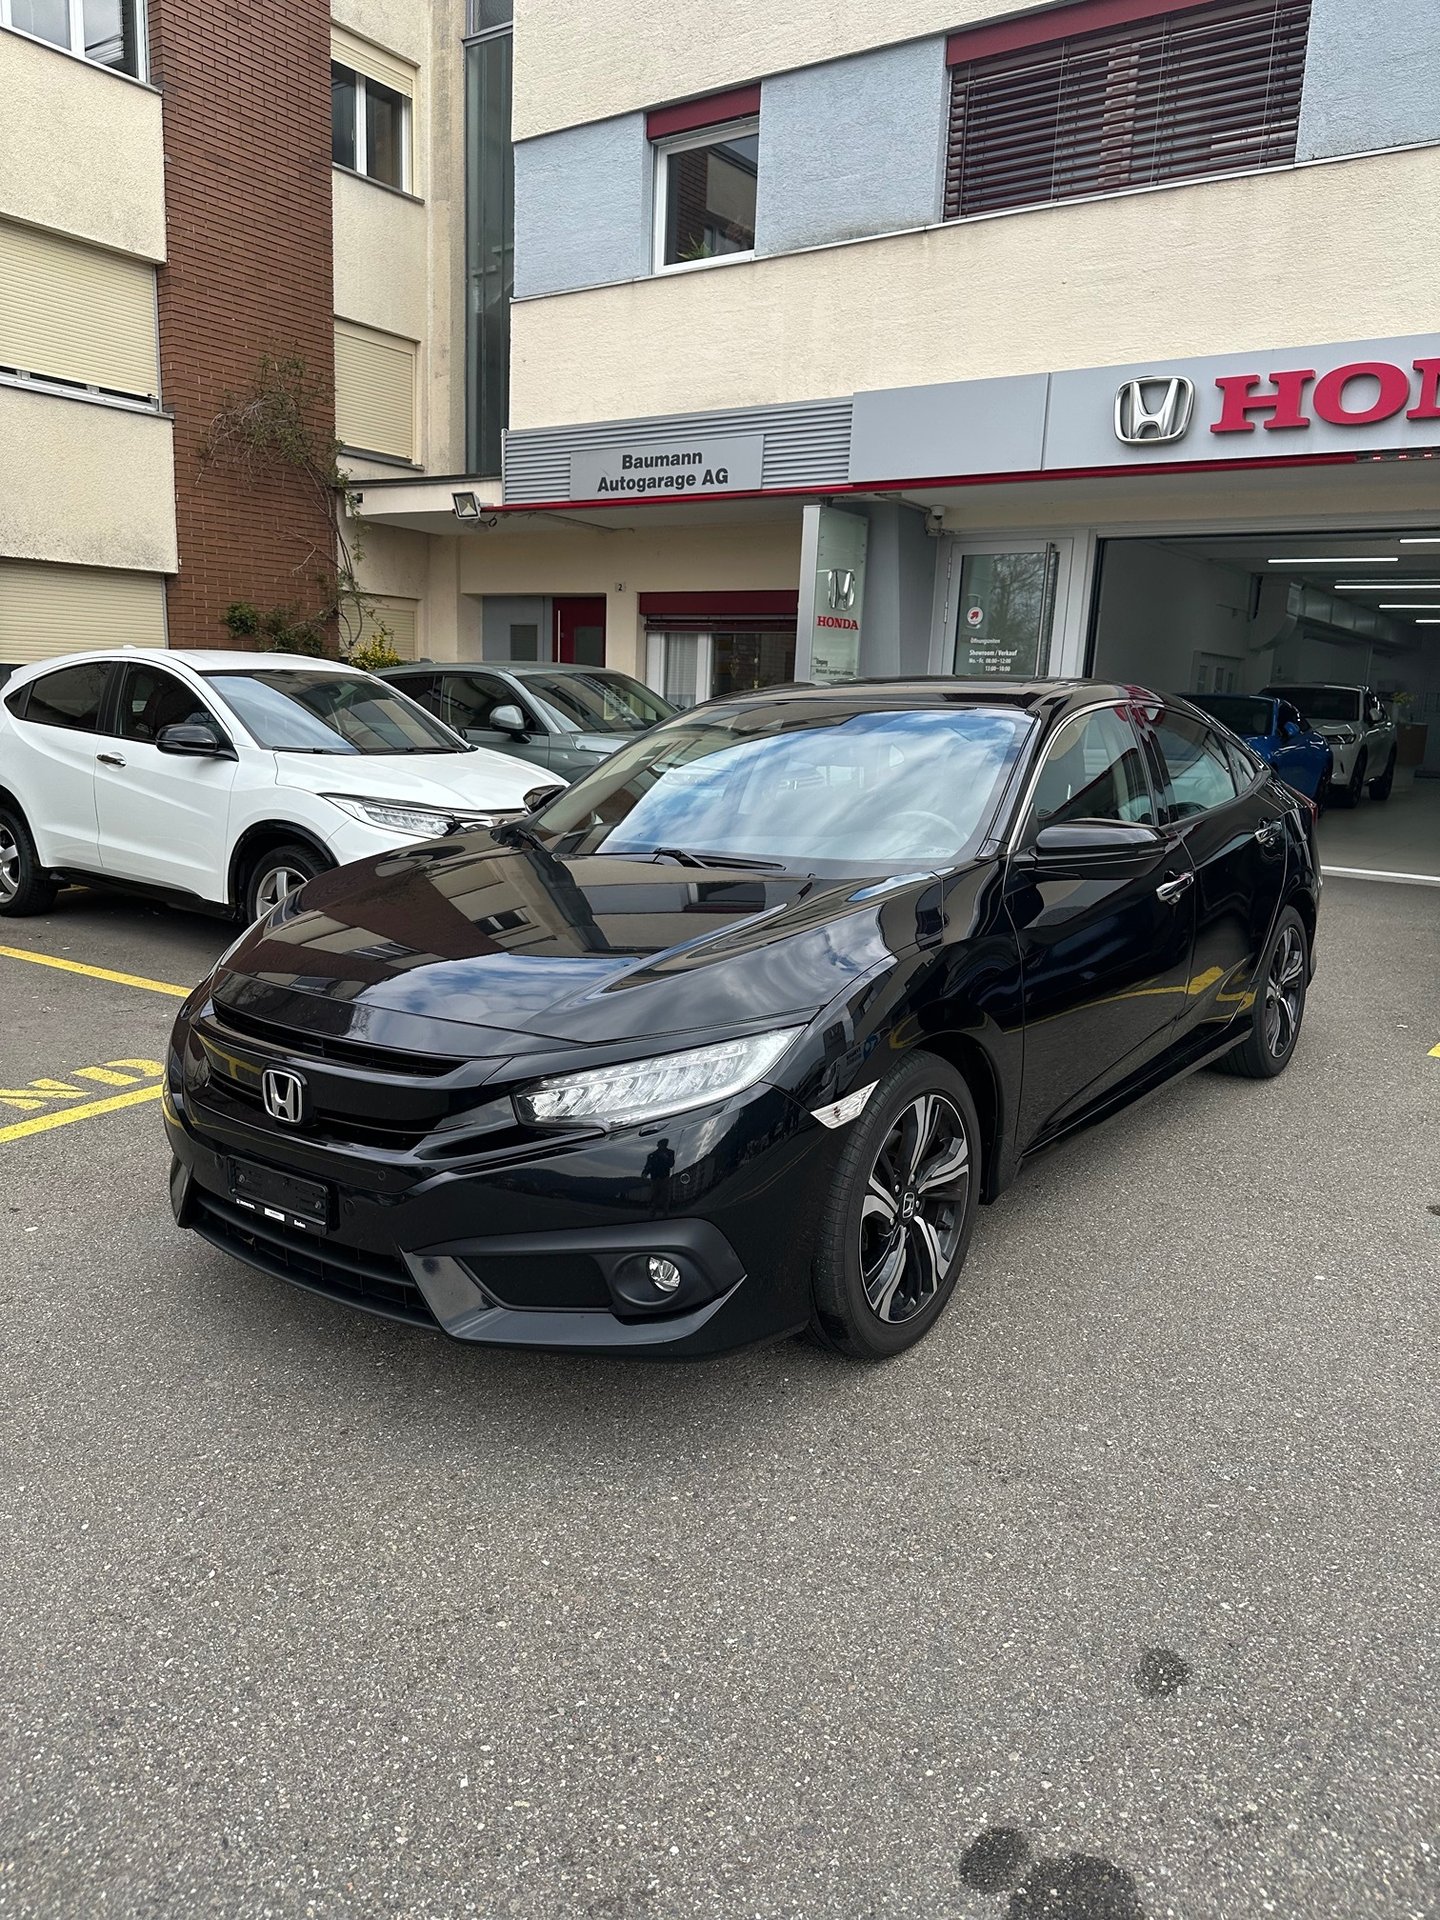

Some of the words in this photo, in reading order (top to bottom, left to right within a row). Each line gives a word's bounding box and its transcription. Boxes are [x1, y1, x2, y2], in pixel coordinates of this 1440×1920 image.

[621, 451, 703, 470] Baumann
[597, 473, 697, 492] Autogarage
[702, 467, 729, 485] AG
[618, 583, 623, 592] 2
[816, 615, 860, 631] HONDA
